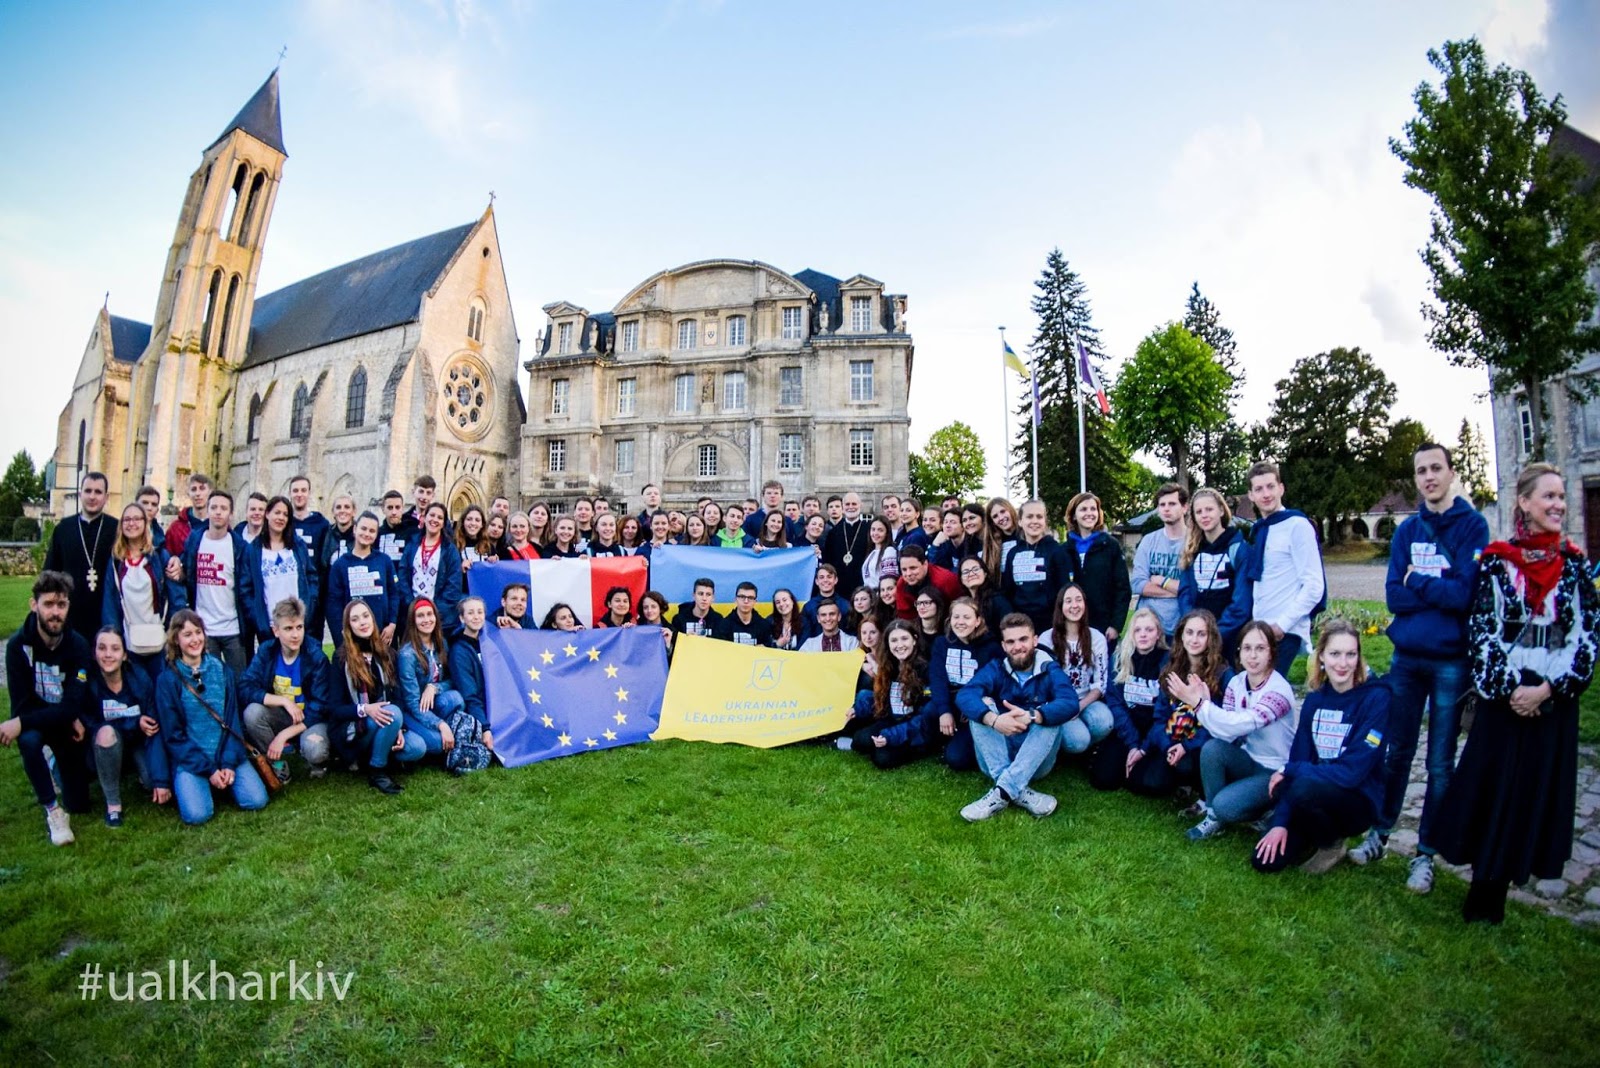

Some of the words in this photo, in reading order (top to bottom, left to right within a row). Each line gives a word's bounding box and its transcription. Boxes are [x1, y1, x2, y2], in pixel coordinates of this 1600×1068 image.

[759, 665, 774, 680] A
[725, 700, 798, 711] UKRAINIAN
[684, 712, 766, 724] LEADERSHIP
[770, 706, 834, 722] ACADEMY
